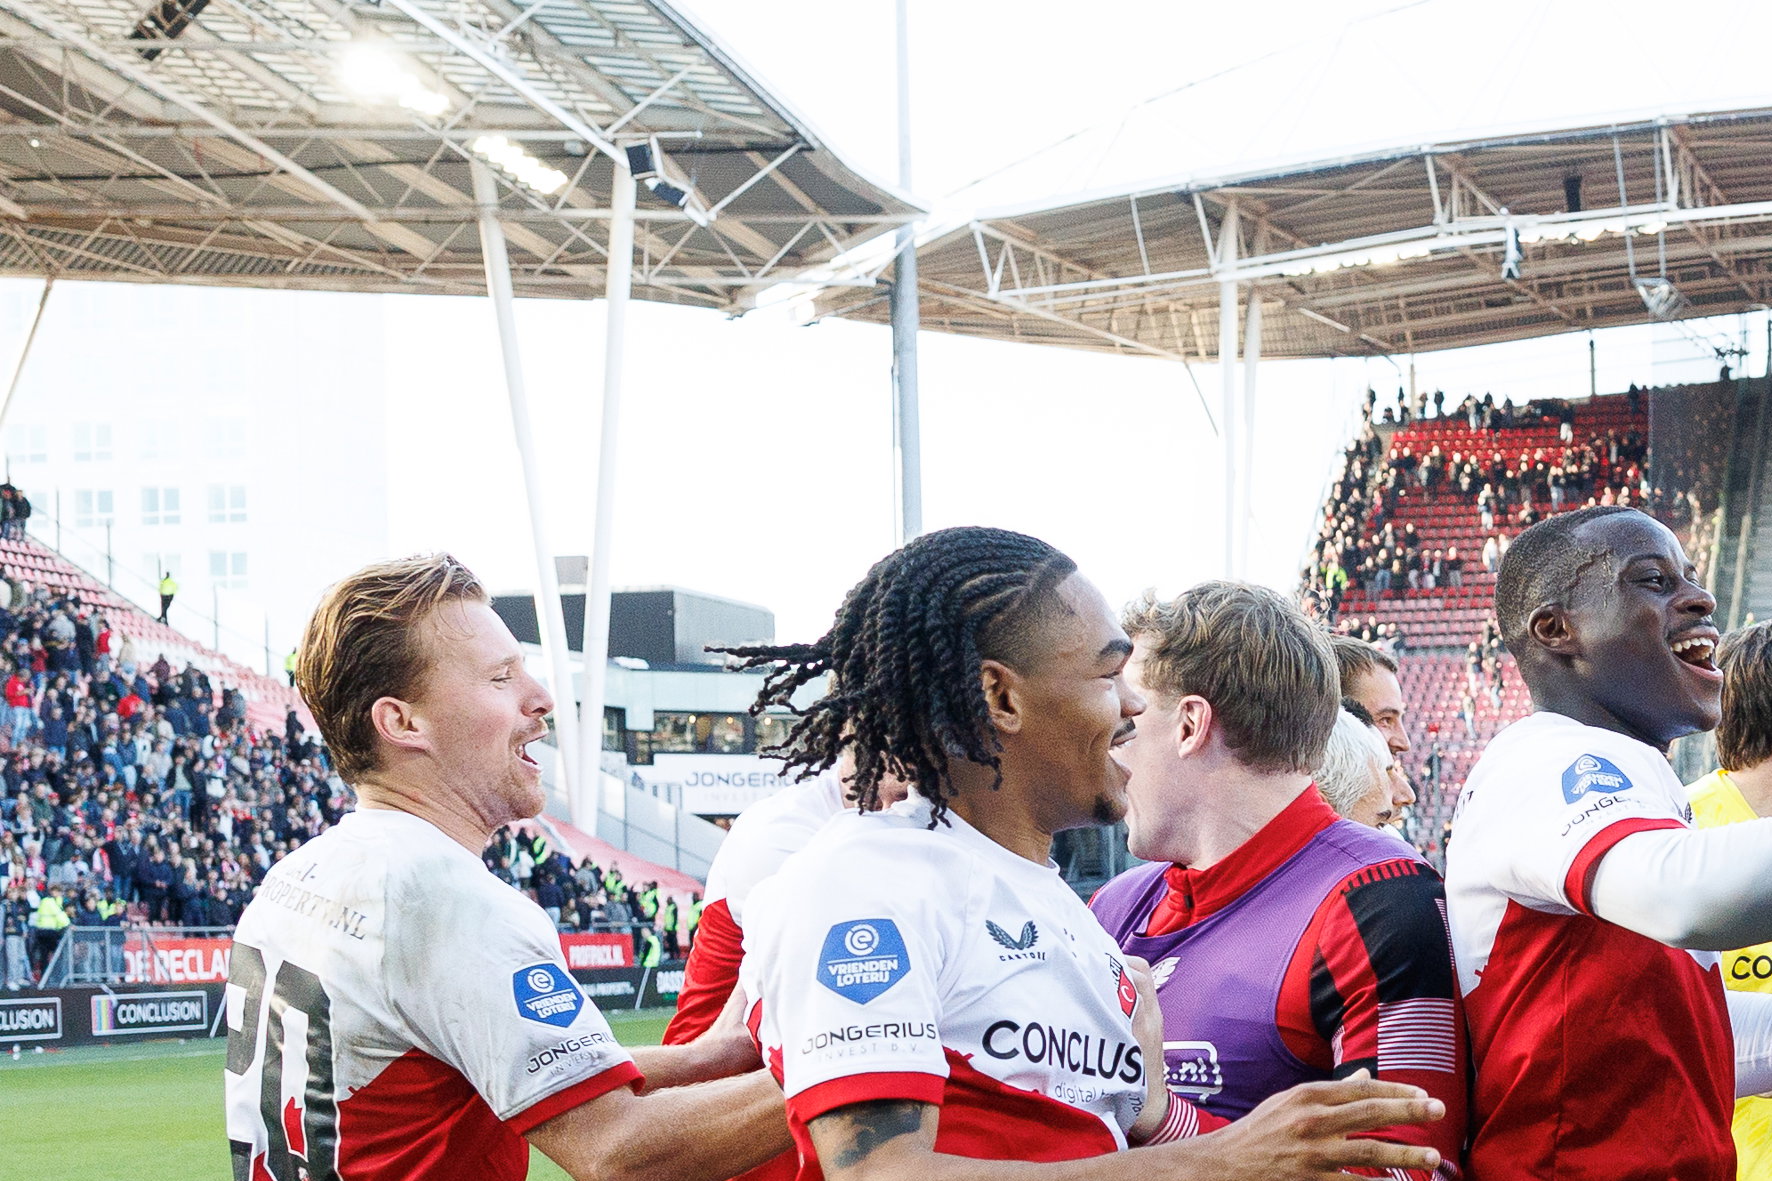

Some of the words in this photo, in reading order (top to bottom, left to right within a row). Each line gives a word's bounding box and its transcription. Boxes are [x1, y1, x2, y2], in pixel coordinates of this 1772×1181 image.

[827, 959, 899, 976] VRIENDEN
[836, 971, 890, 988] LOTERIJ
[526, 992, 577, 1012] VRIENDEN
[537, 1002, 576, 1019] LOTERIJ
[117, 1001, 201, 1025] CONCLUSION
[801, 1022, 936, 1055] JONGERIUS
